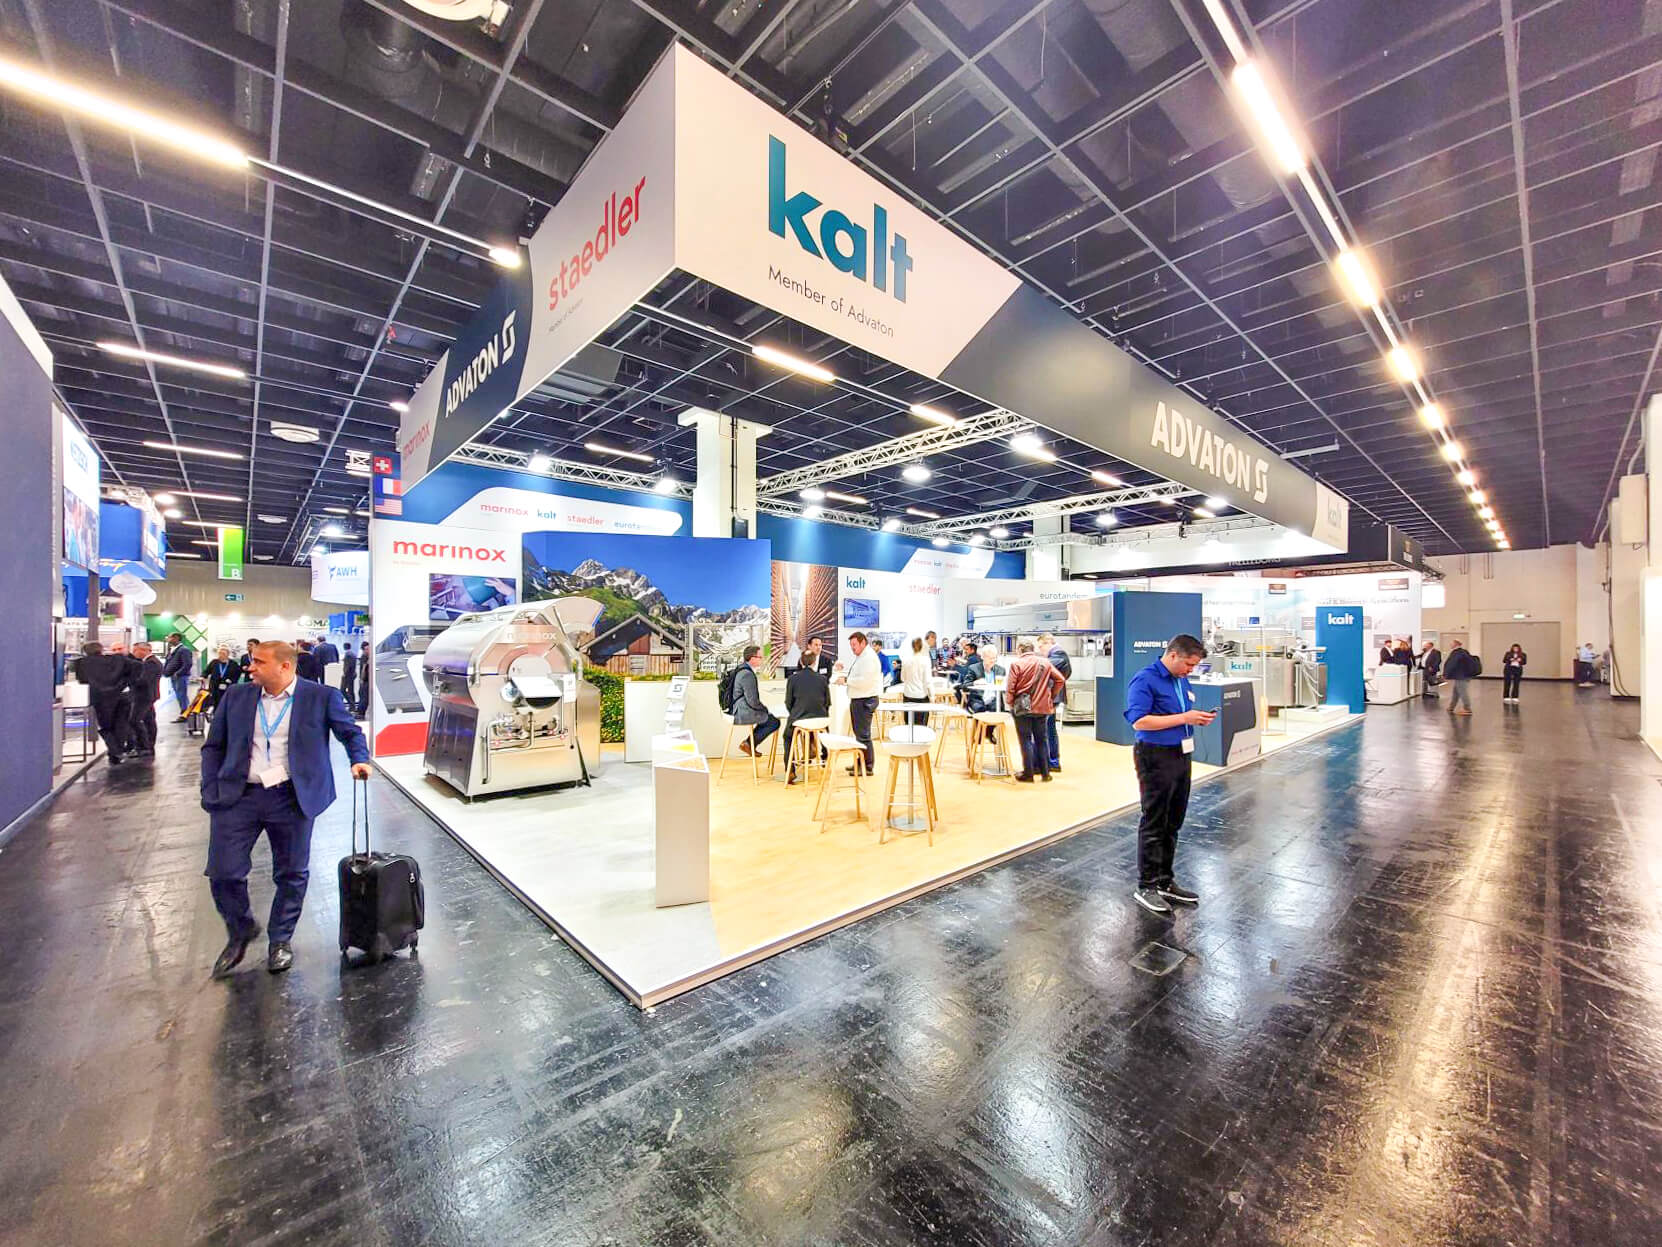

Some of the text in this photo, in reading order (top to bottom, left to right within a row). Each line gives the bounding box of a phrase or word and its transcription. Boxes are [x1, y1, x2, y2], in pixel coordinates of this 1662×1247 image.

[769, 133, 914, 304] kalt
[549, 175, 646, 311] staedler
[768, 265, 895, 338] Member of Advaton
[445, 333, 498, 418] ADVATON
[1151, 401, 1250, 492] ADVATON
[480, 504, 528, 516] marinox
[537, 509, 557, 520] kalt
[567, 514, 604, 525] staedler
[393, 541, 506, 562] marinox
[231, 568, 241, 578] B
[336, 567, 358, 577] AWH
[846, 576, 866, 588] kalt
[1328, 613, 1354, 625] kalt
[1231, 661, 1253, 671] kalt
